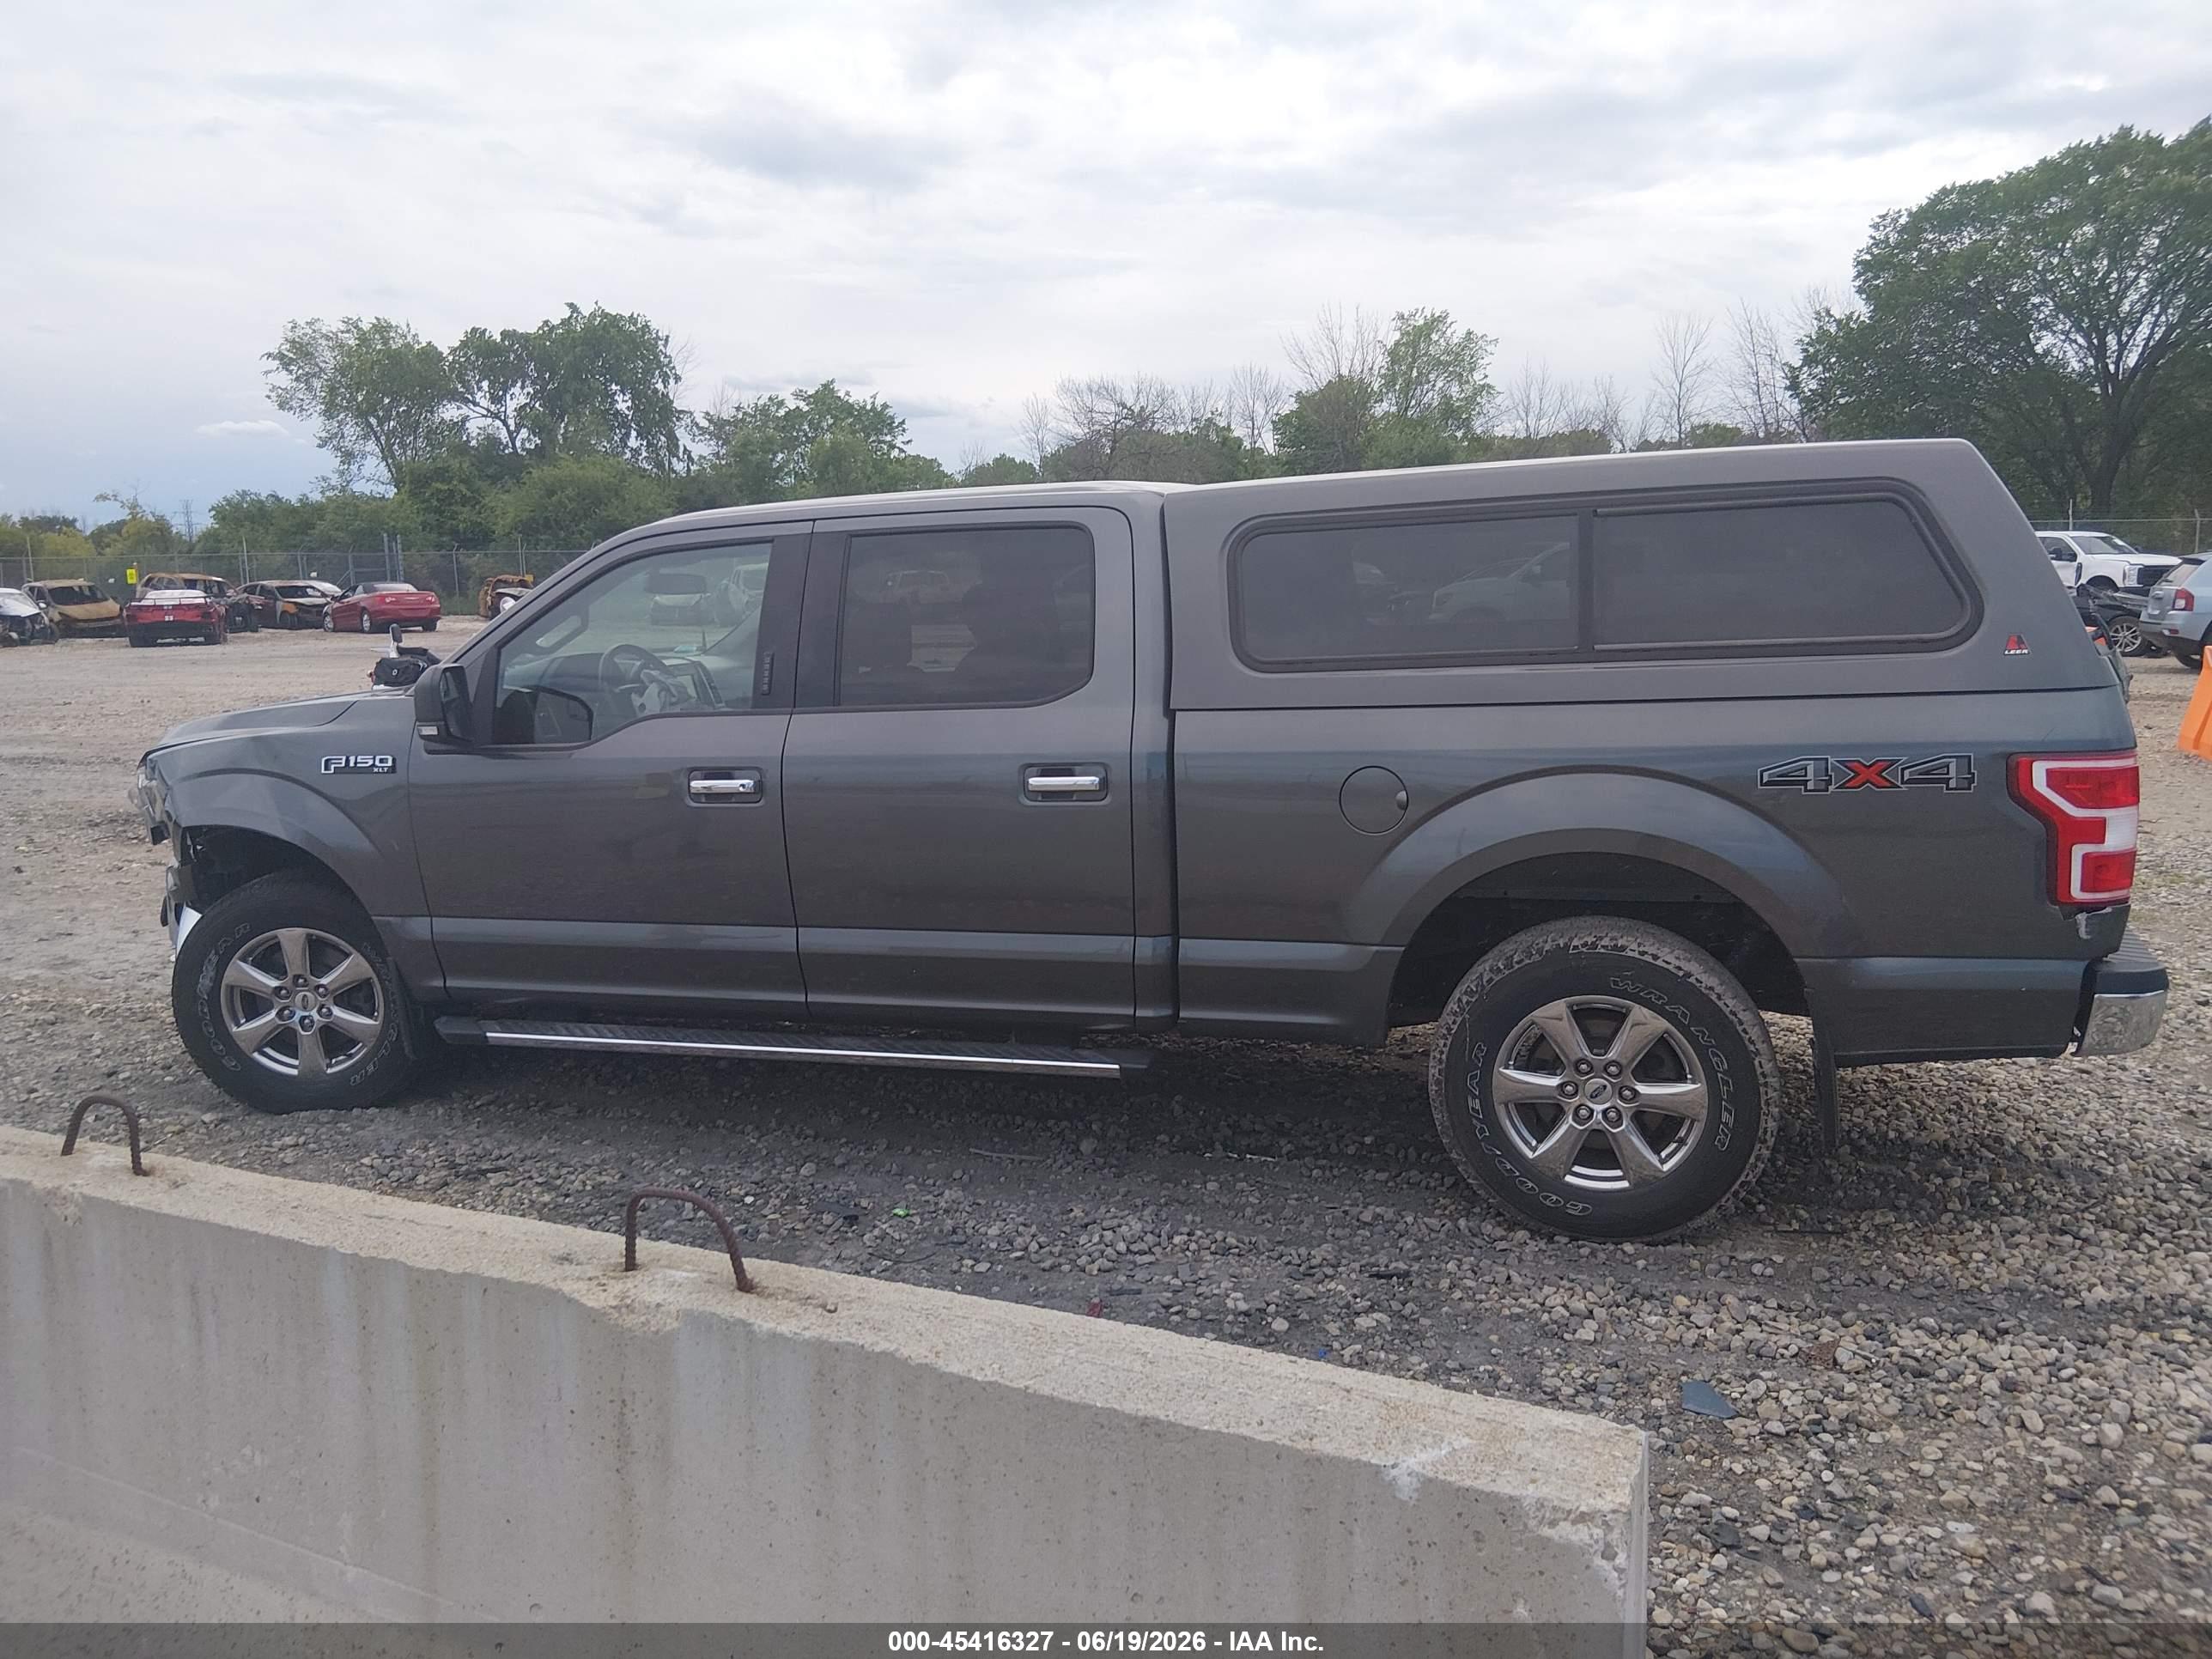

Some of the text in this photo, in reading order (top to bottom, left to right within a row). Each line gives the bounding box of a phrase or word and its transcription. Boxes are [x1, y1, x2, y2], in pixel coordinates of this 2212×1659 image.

[321, 755, 394, 774] F150
[1466, 1042, 1593, 1216] GOODYEAR
[1609, 976, 1735, 1152] WRANGLER
